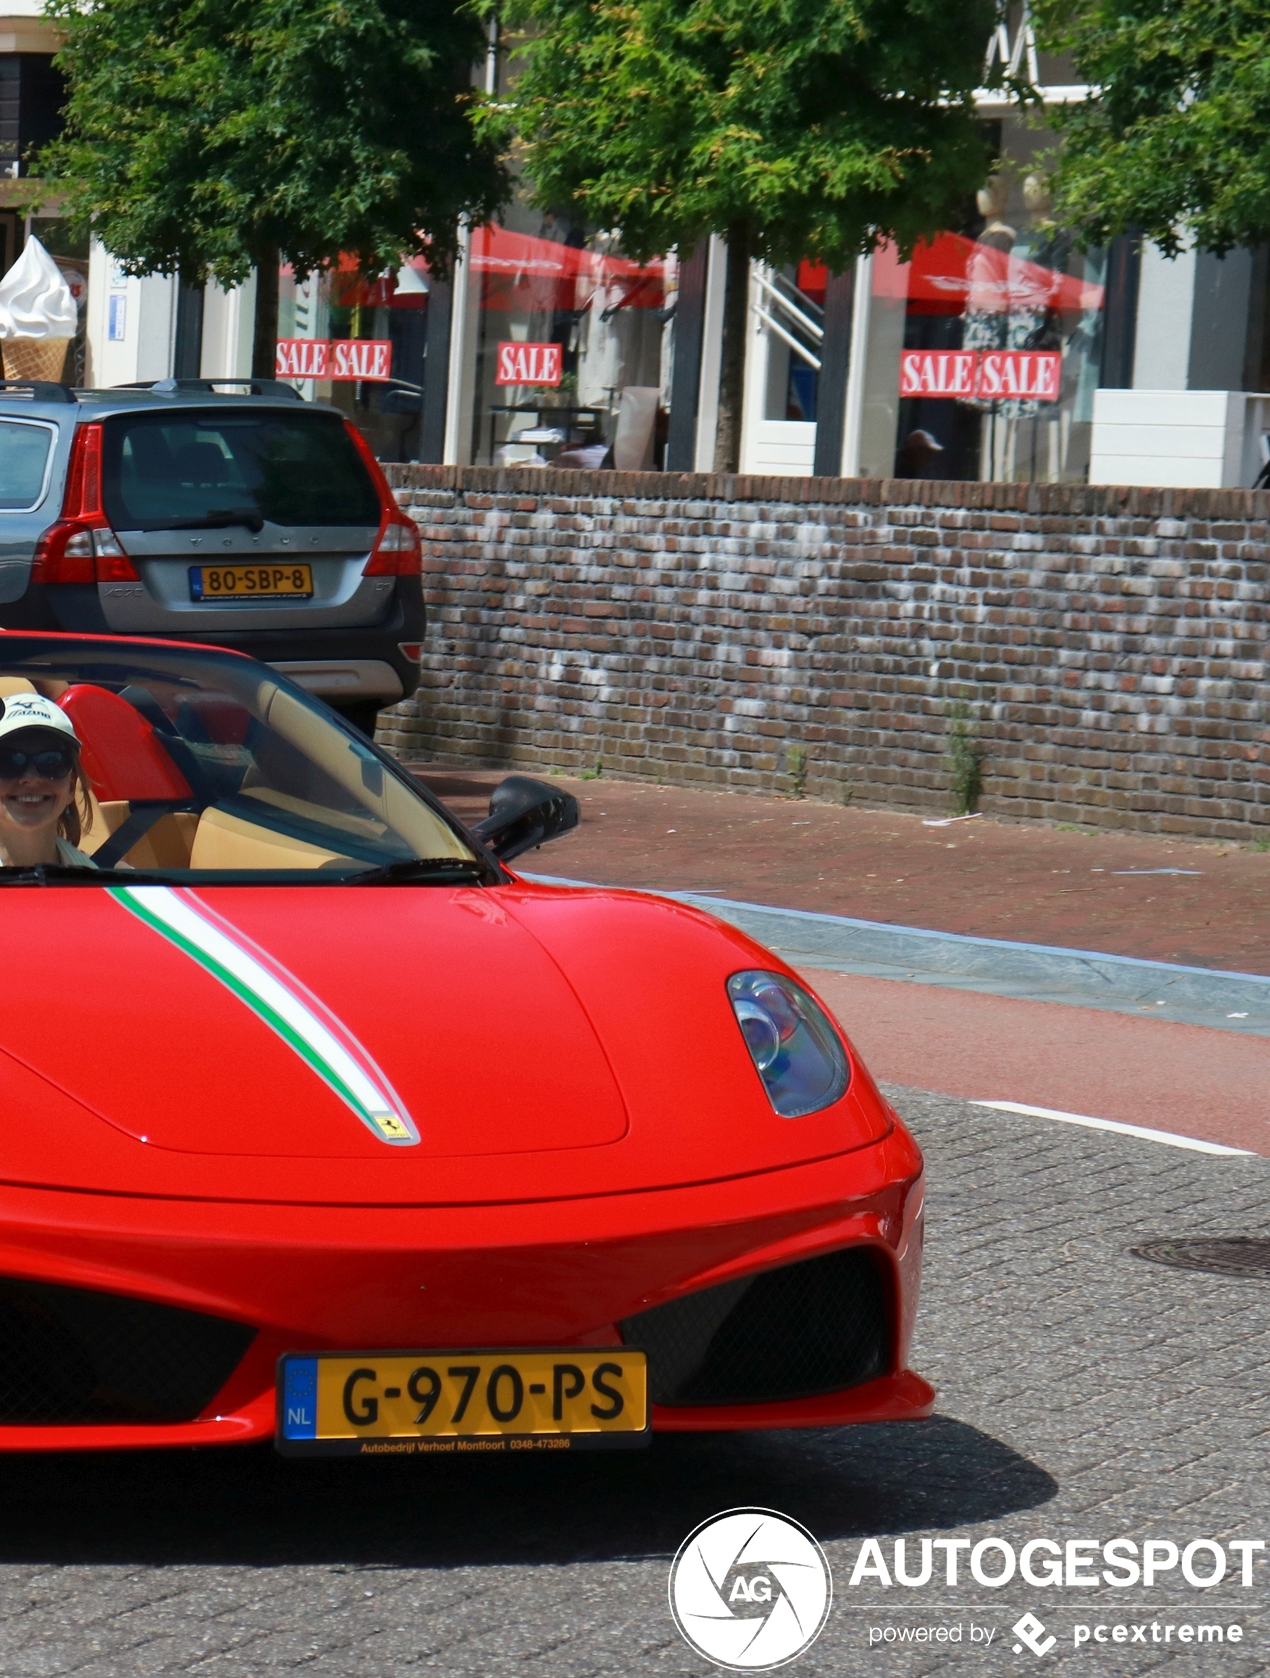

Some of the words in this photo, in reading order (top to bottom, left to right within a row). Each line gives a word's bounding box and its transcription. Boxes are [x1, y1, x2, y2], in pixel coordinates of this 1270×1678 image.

[276, 342, 326, 375] SALE
[334, 343, 387, 377] SALE
[500, 346, 558, 381] SALE
[903, 354, 973, 393] SALE
[982, 355, 1056, 395] SALE
[208, 569, 304, 591] 80-SBP-8
[342, 1363, 624, 1426] G-970-PS
[288, 1407, 311, 1425] NL
[361, 1442, 415, 1454] Autobedrijf
[417, 1441, 455, 1452] Verhoef
[457, 1440, 505, 1451] Montfoort
[510, 1438, 571, 1449] 0348-473286
